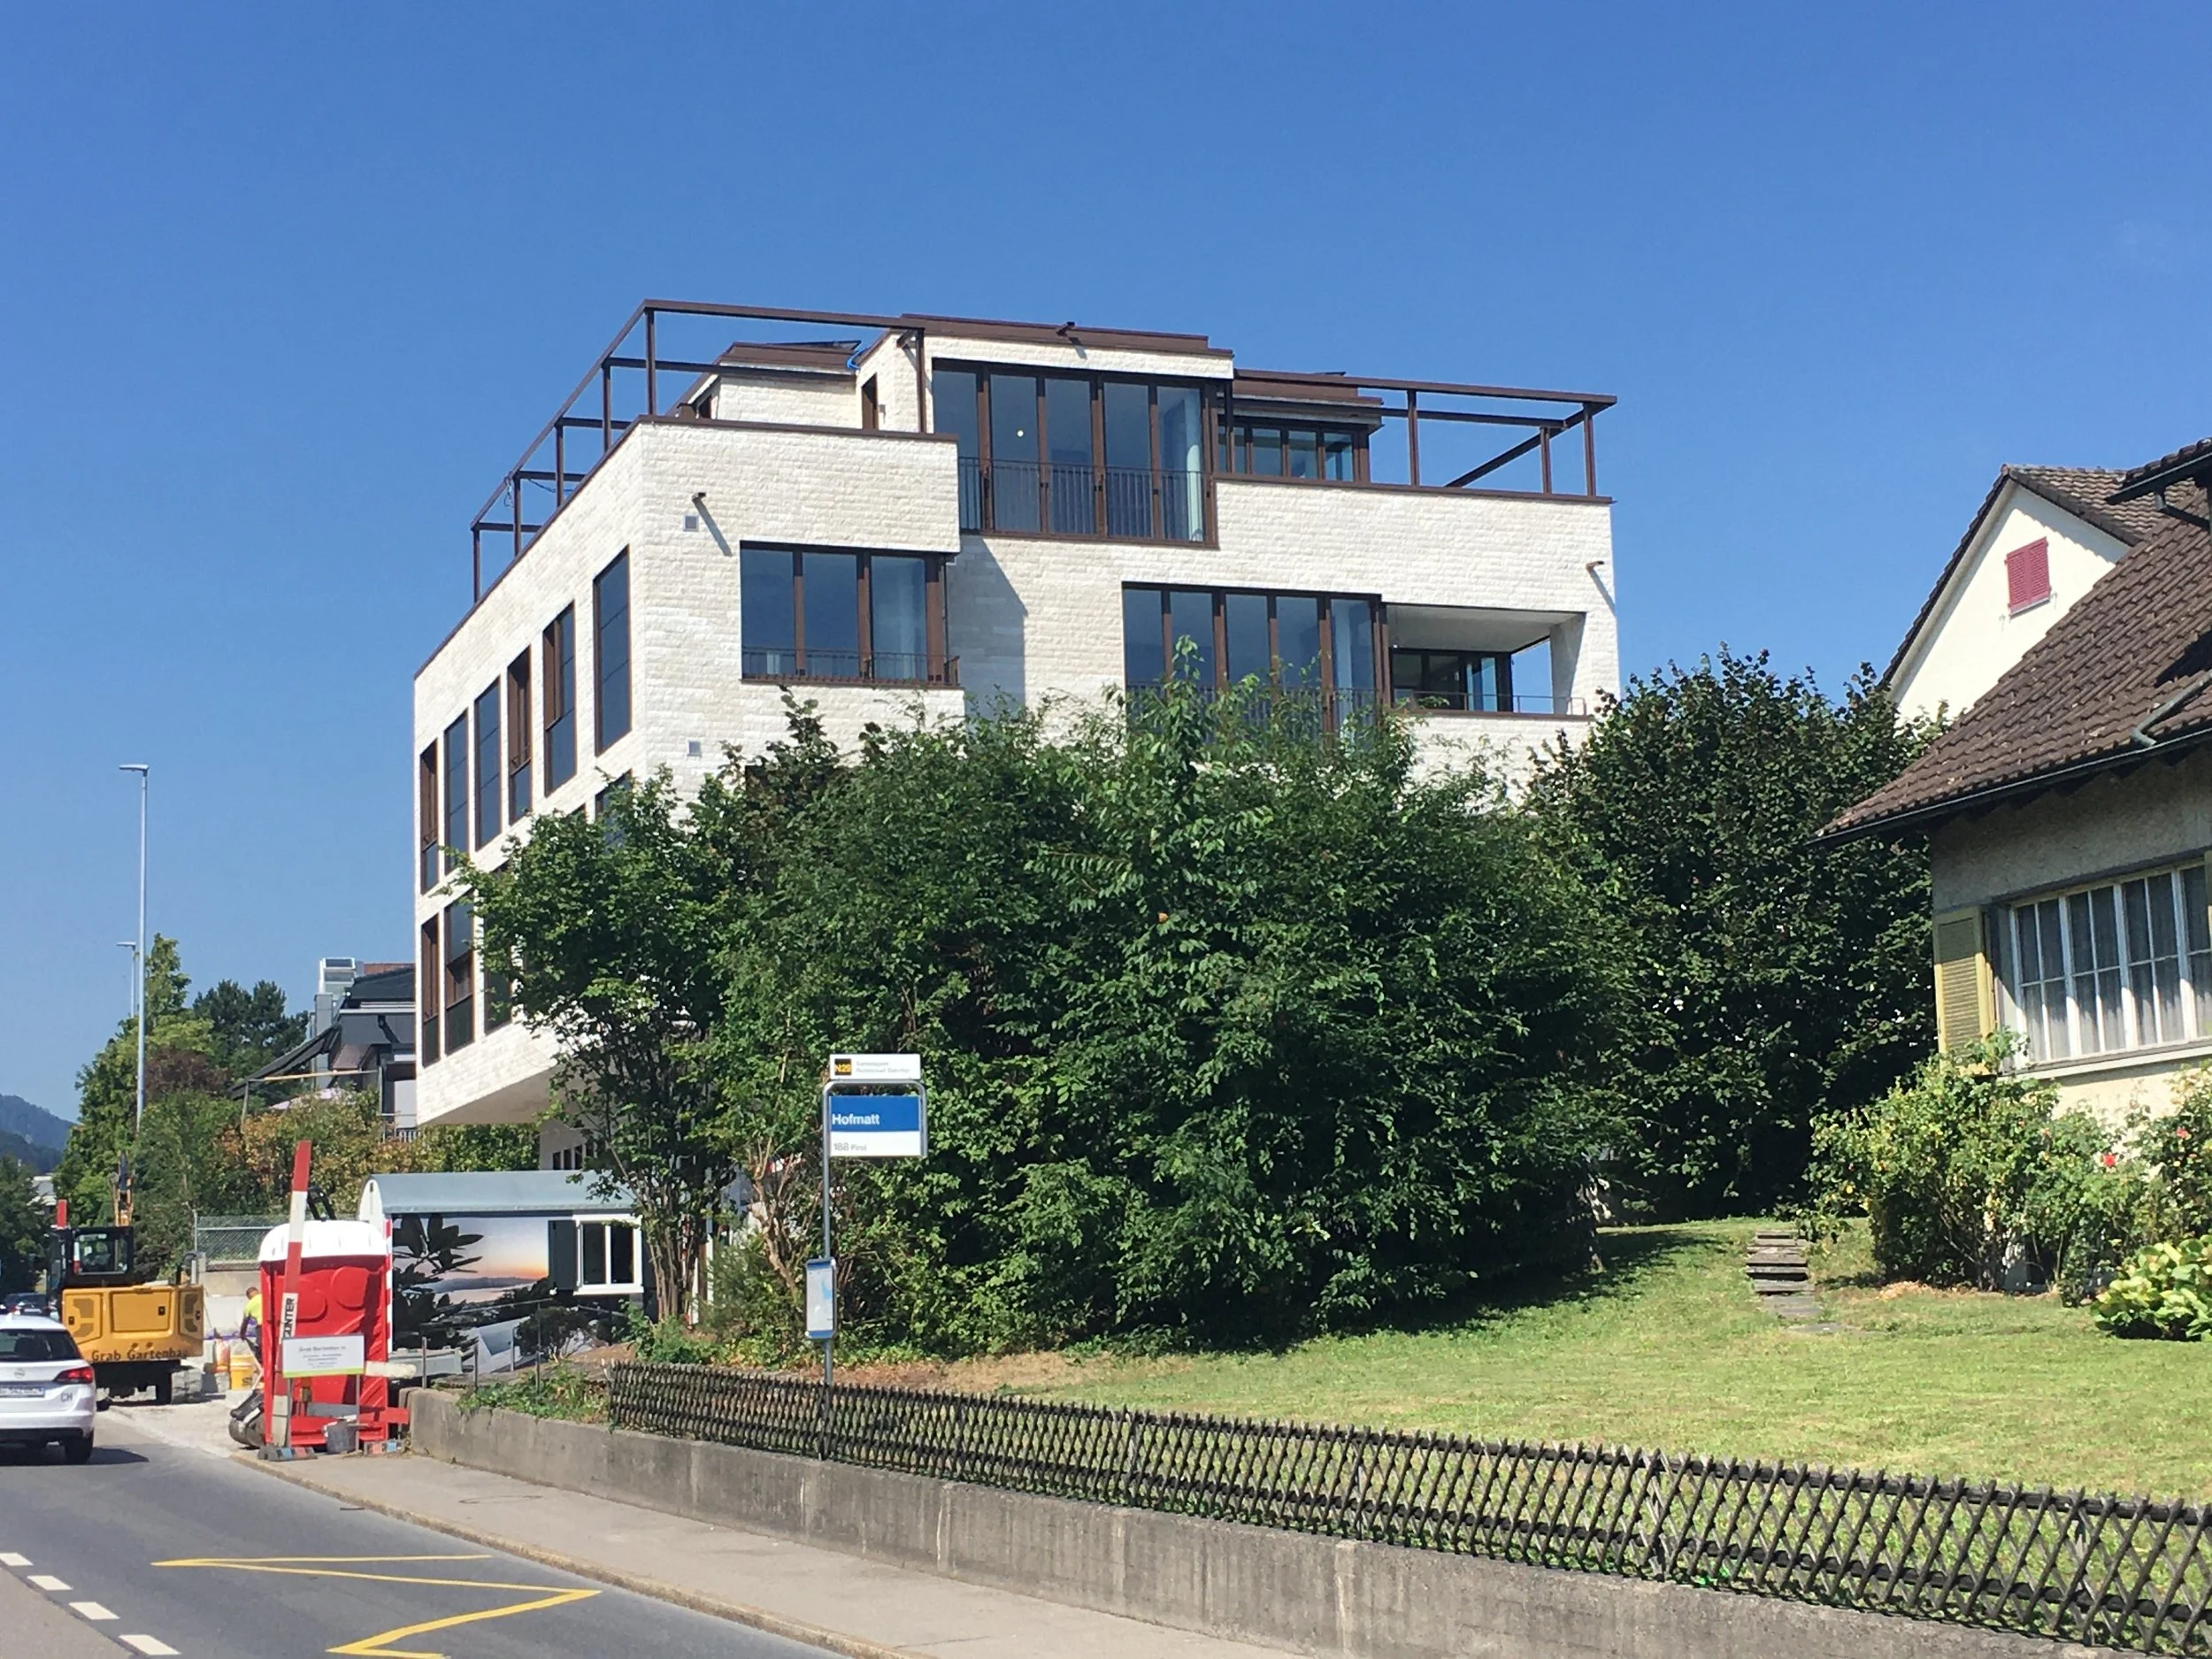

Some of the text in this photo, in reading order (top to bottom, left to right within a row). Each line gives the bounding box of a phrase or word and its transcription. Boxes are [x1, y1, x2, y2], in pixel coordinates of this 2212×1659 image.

[832, 1113, 880, 1125] Hofmatt
[833, 1142, 849, 1152] 188
[91, 1347, 188, 1362] Grab Gartenbau
[60, 1392, 73, 1402] CH
